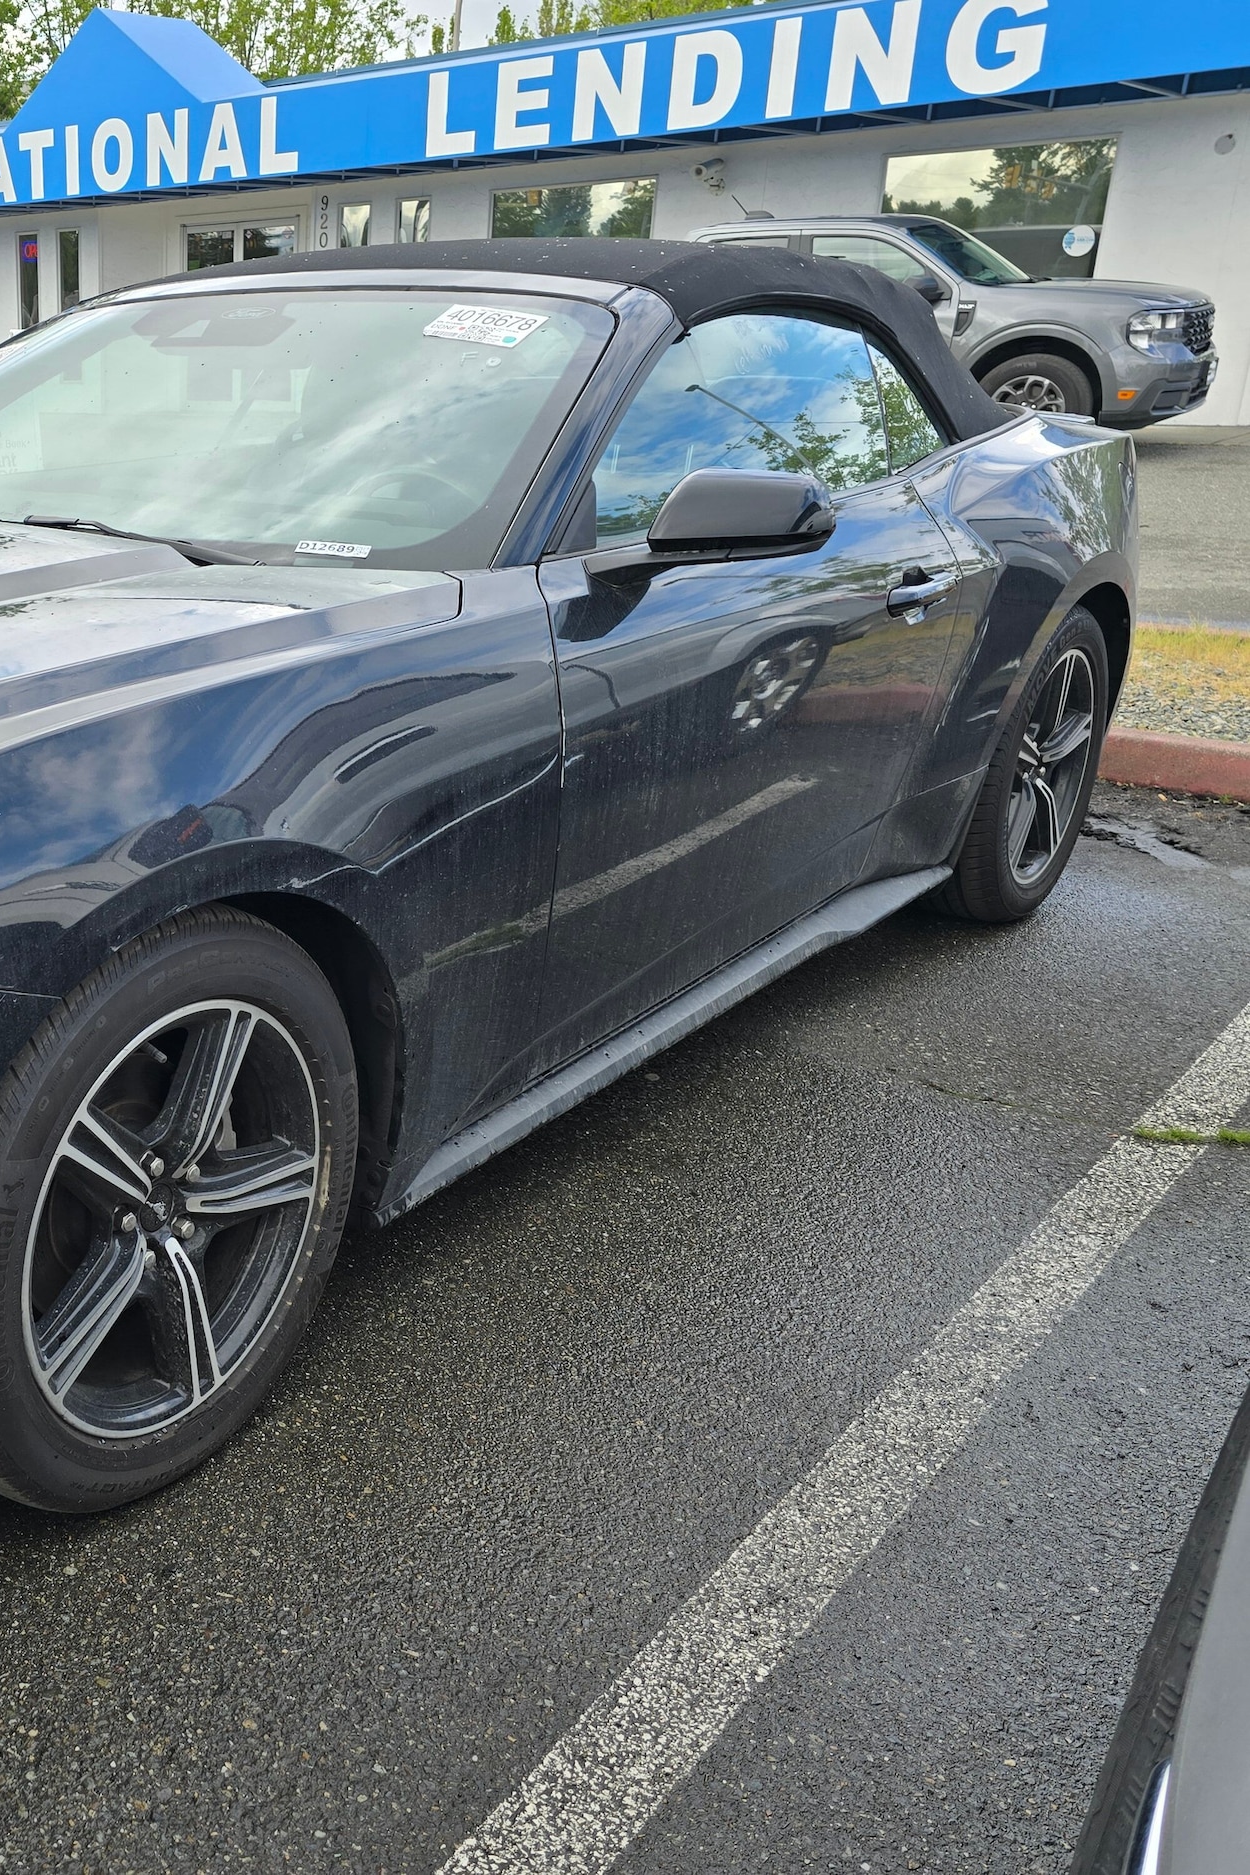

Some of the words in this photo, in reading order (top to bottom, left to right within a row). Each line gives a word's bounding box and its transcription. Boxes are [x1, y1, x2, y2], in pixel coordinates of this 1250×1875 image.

[425, 0, 1049, 159] LENDING
[447, 309, 537, 331] 4016678
[298, 542, 355, 554] D12689
